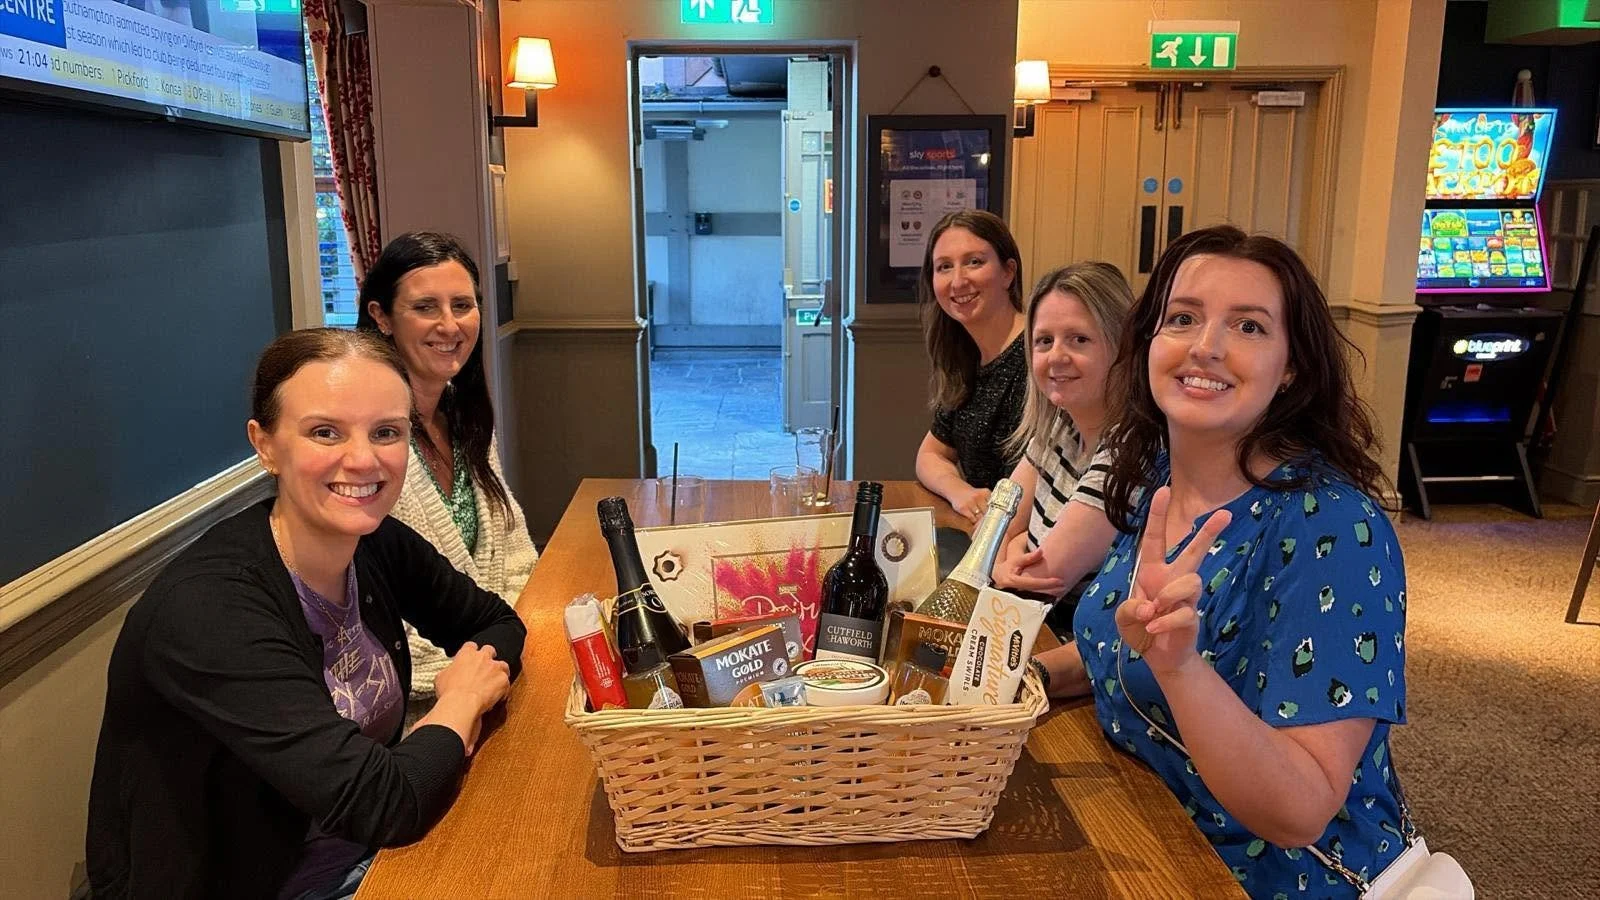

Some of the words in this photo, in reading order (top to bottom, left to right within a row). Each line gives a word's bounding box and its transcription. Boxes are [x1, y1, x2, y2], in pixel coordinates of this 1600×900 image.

[77, 29, 107, 48] season
[18, 48, 48, 68] 21:04
[117, 69, 149, 89] Pickford
[161, 80, 182, 96] Konsa
[909, 150, 924, 160] sky
[926, 149, 957, 160] sports
[1467, 339, 1521, 355] blueprint
[827, 625, 873, 640] CUTFIELD
[830, 634, 873, 649] HAWORTH
[918, 626, 964, 646] MOKA
[968, 629, 977, 657] CREAM
[980, 597, 1020, 705] Signature
[715, 639, 773, 671] MOKATE
[975, 641, 985, 681] CHOCOLATE
[732, 659, 764, 678] GOLD
[735, 671, 764, 684] PREMIUM
[963, 661, 973, 691] SWIRLS
